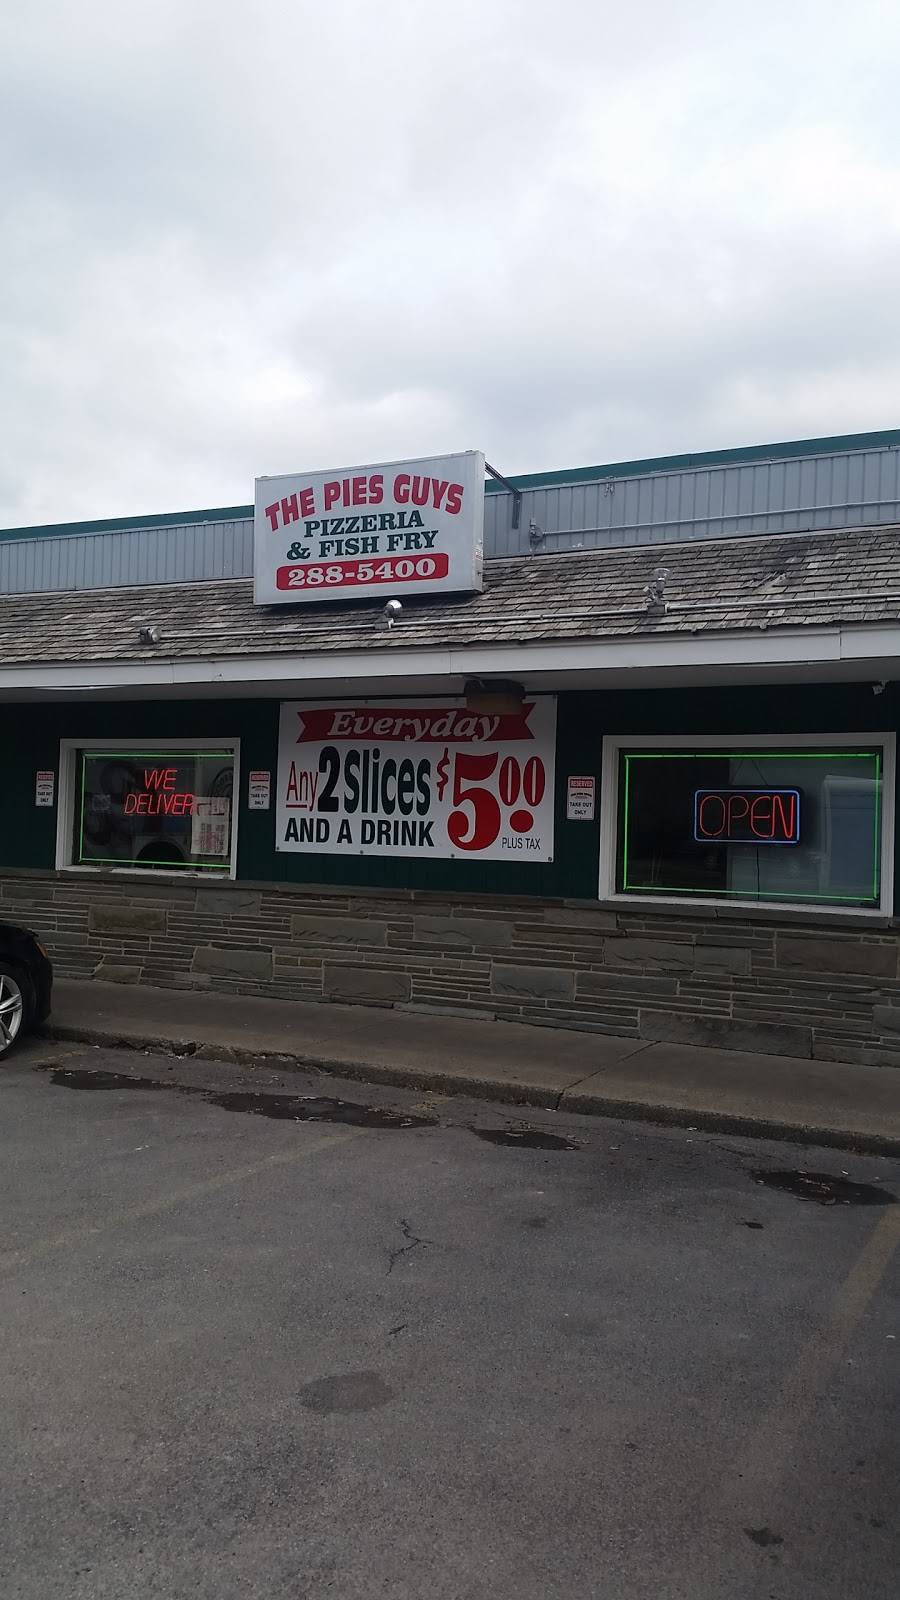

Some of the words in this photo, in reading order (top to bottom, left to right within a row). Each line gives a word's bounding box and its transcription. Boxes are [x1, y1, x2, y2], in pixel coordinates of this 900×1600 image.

[265, 487, 316, 532] THE
[323, 475, 384, 512] PIES
[393, 473, 465, 516] GUYS
[304, 510, 424, 538] PIZZERIA
[286, 541, 311, 561] &
[318, 536, 380, 558] FISH
[386, 530, 439, 552] FRY
[288, 558, 436, 586] 288-5400
[327, 711, 500, 742] Everyday
[144, 768, 178, 791] WE
[286, 761, 319, 812] Any
[317, 745, 341, 813] 2
[343, 748, 431, 816] Slices
[570, 779, 593, 787] RESERVED
[700, 795, 795, 838] OPEN
[284, 817, 330, 843] AND
[336, 818, 353, 844] A
[360, 819, 435, 847] DRINK
[501, 837, 523, 849] PLUS
[525, 838, 541, 850] TAX
